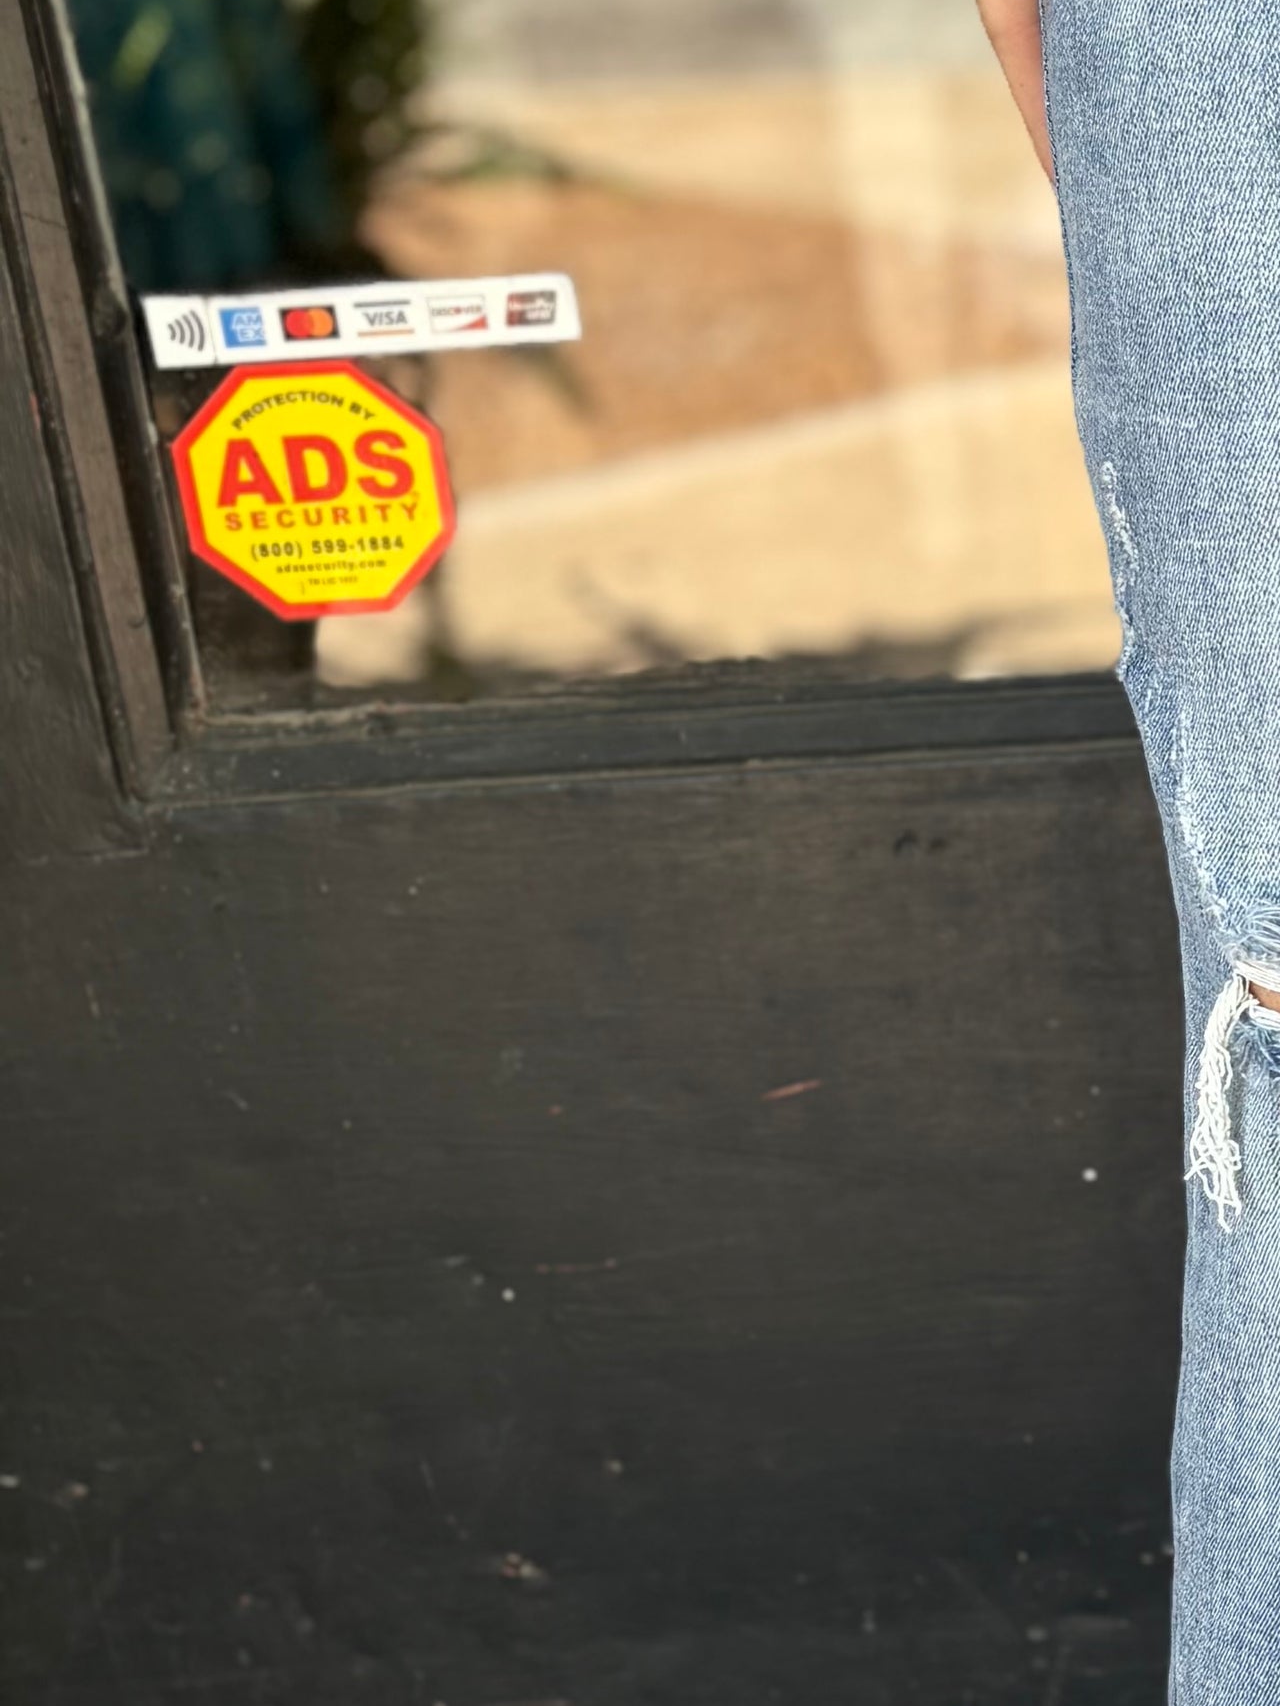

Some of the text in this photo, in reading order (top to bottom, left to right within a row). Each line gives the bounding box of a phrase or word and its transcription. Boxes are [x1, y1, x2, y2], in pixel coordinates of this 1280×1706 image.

[362, 311, 408, 327] VISA
[231, 390, 376, 431] PROTECTION BY
[217, 429, 415, 508] ADS
[224, 501, 418, 532] SECURITY
